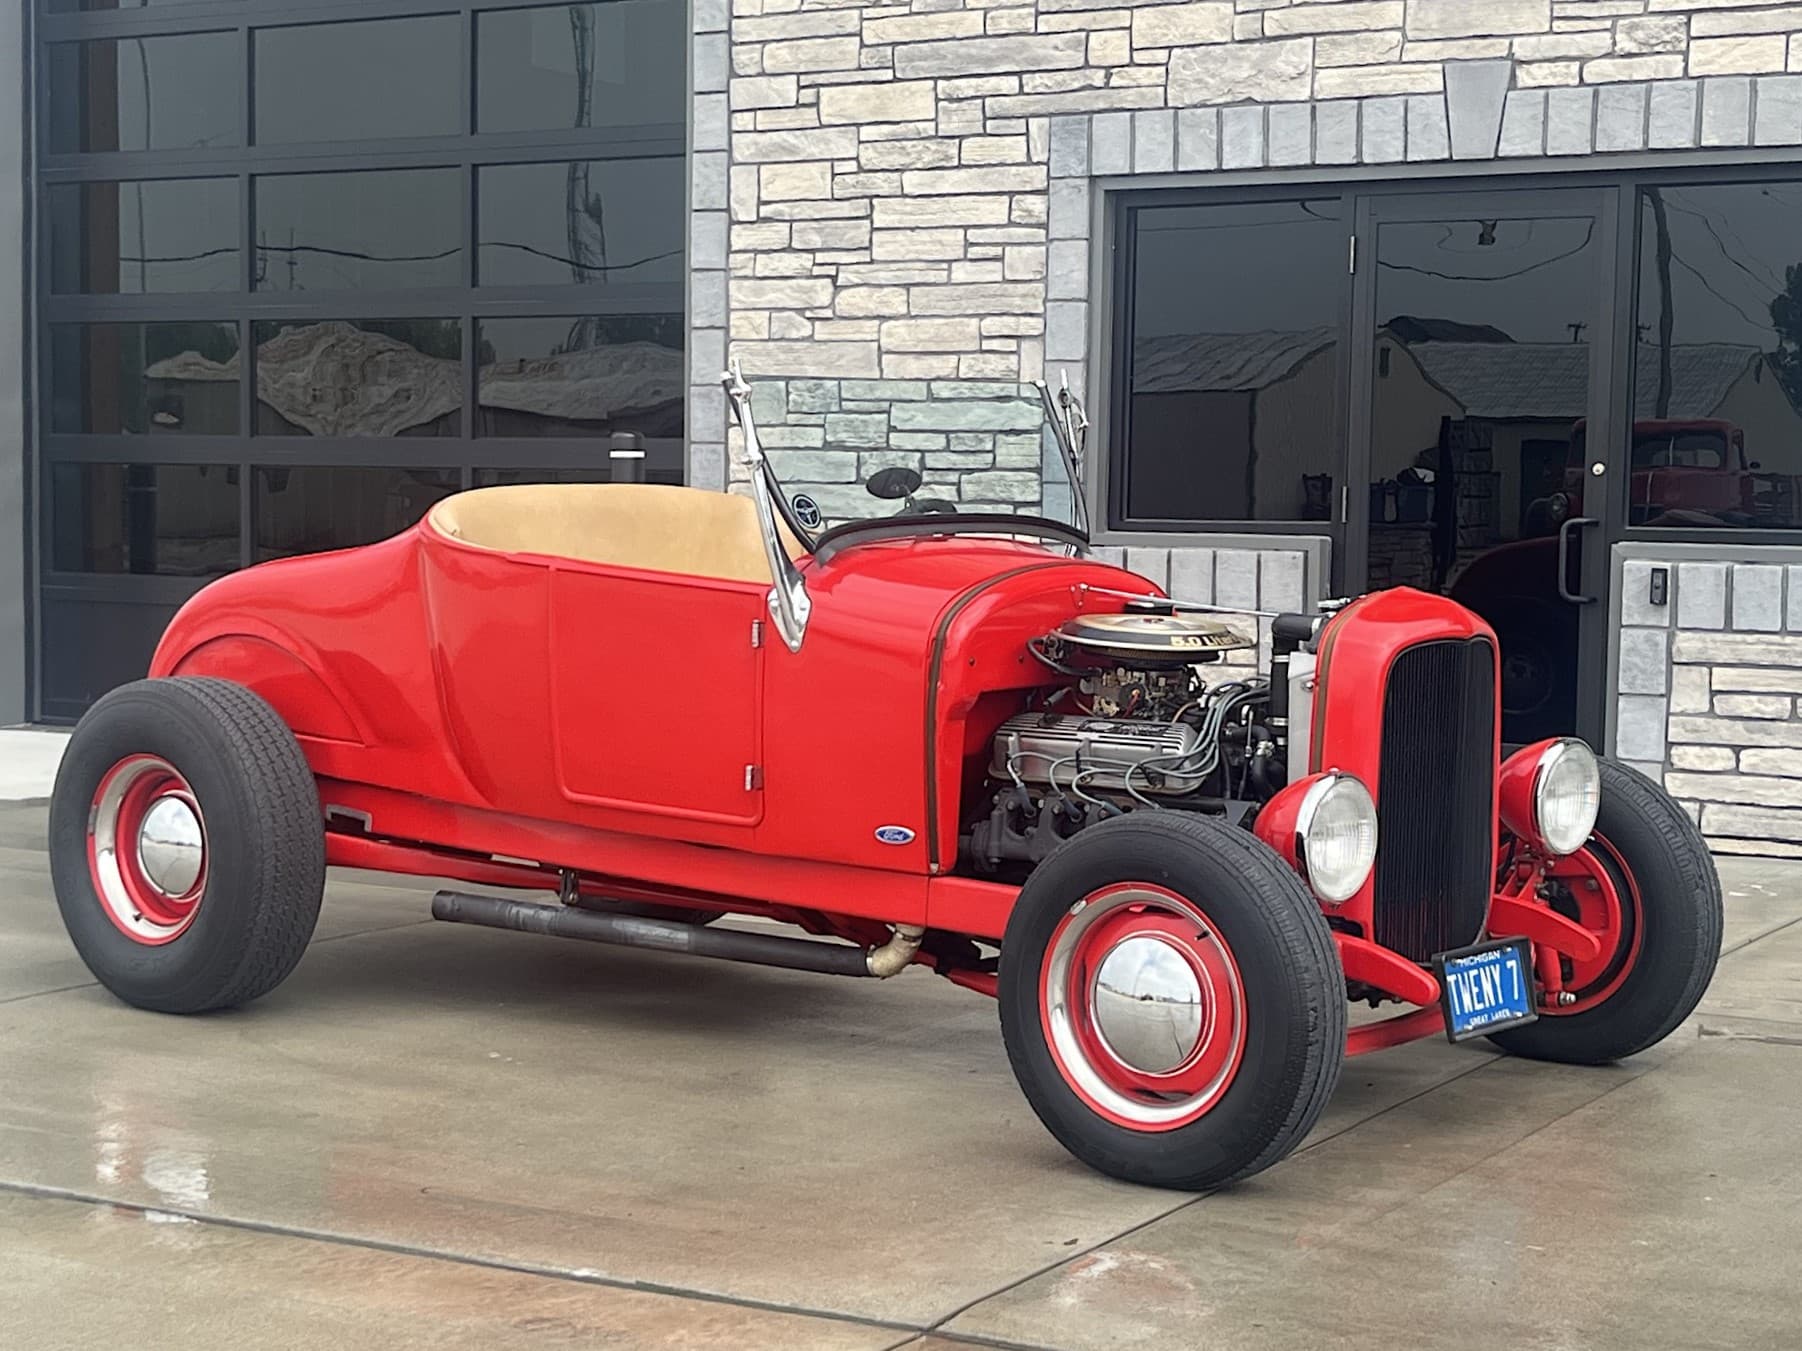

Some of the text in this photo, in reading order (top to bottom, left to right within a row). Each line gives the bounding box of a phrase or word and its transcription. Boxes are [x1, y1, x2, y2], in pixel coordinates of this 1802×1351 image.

[1170, 635, 1202, 647] 5.0
[1459, 950, 1500, 966] MICHIGAN
[1446, 959, 1519, 1016] TWENY 7
